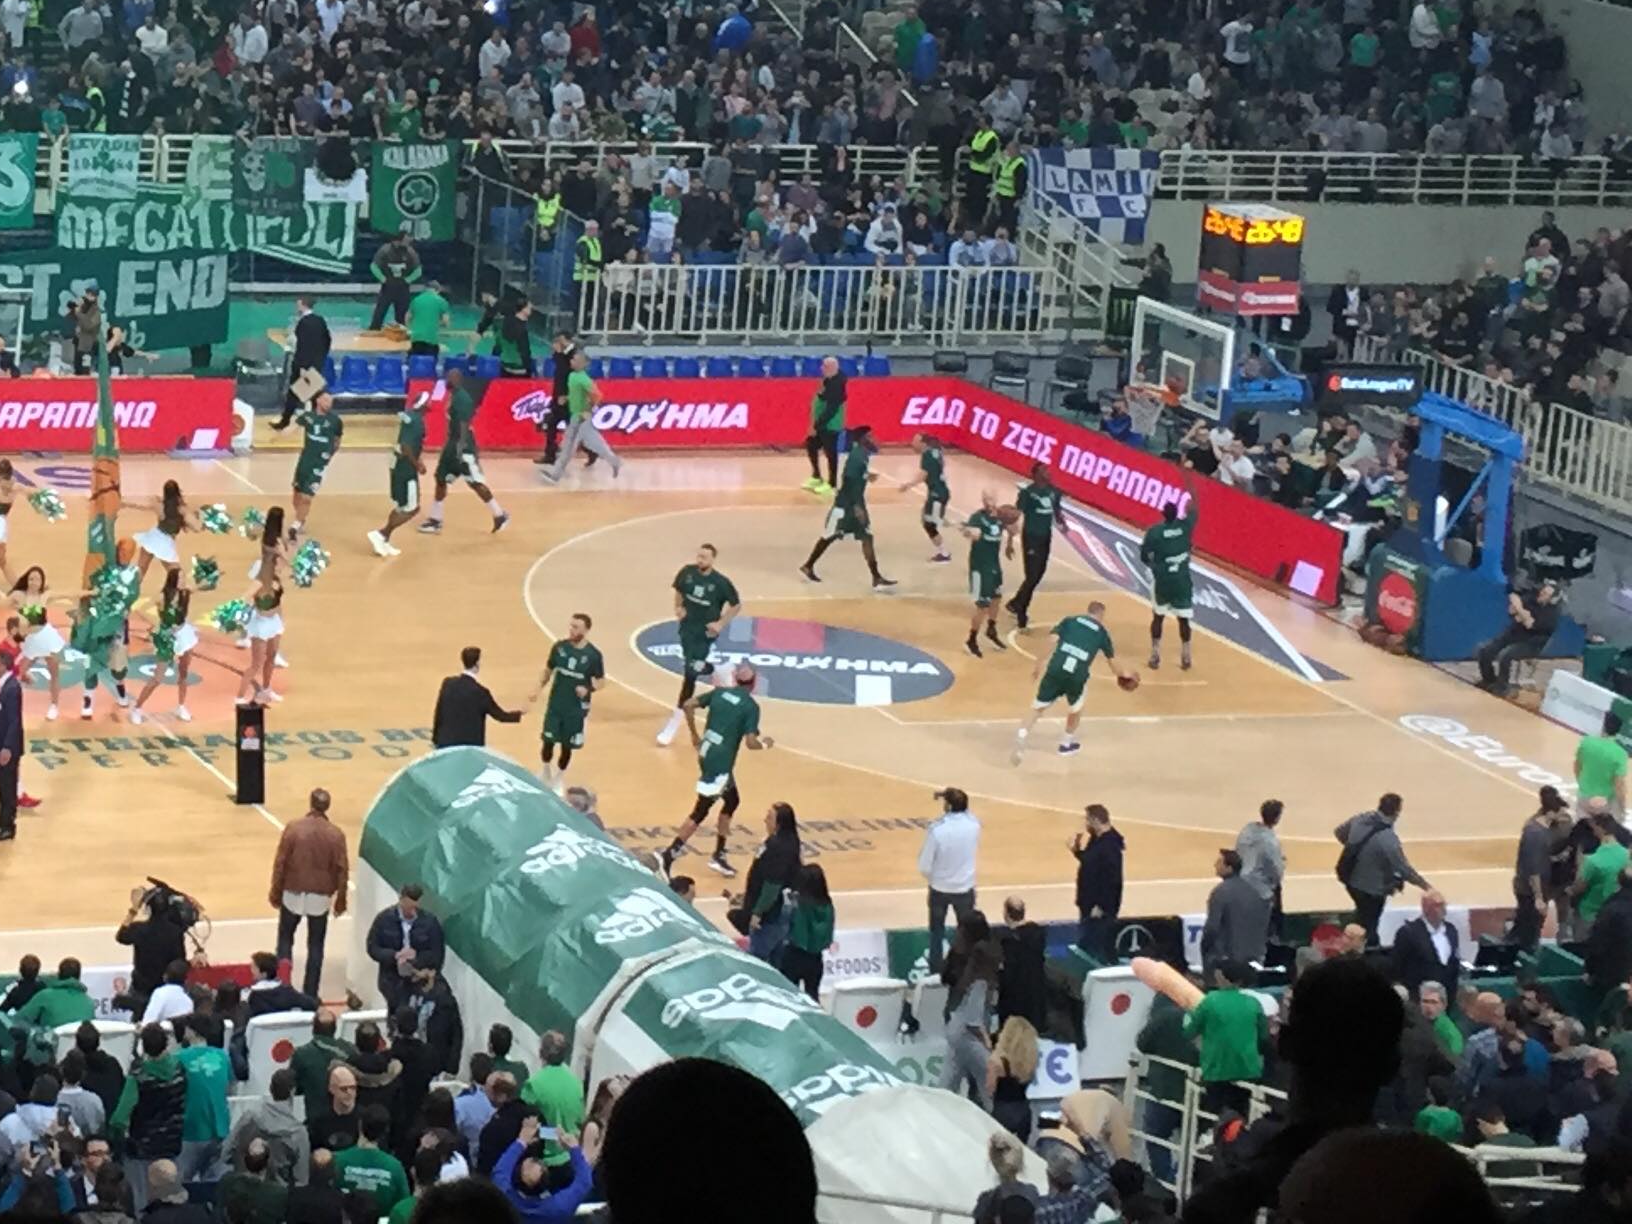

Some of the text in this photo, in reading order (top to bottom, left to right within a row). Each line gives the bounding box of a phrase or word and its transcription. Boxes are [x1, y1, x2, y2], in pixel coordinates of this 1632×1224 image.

[115, 254, 228, 318] END
[901, 395, 963, 426] ΕΔΩ
[826, 957, 882, 975] RFOODS
